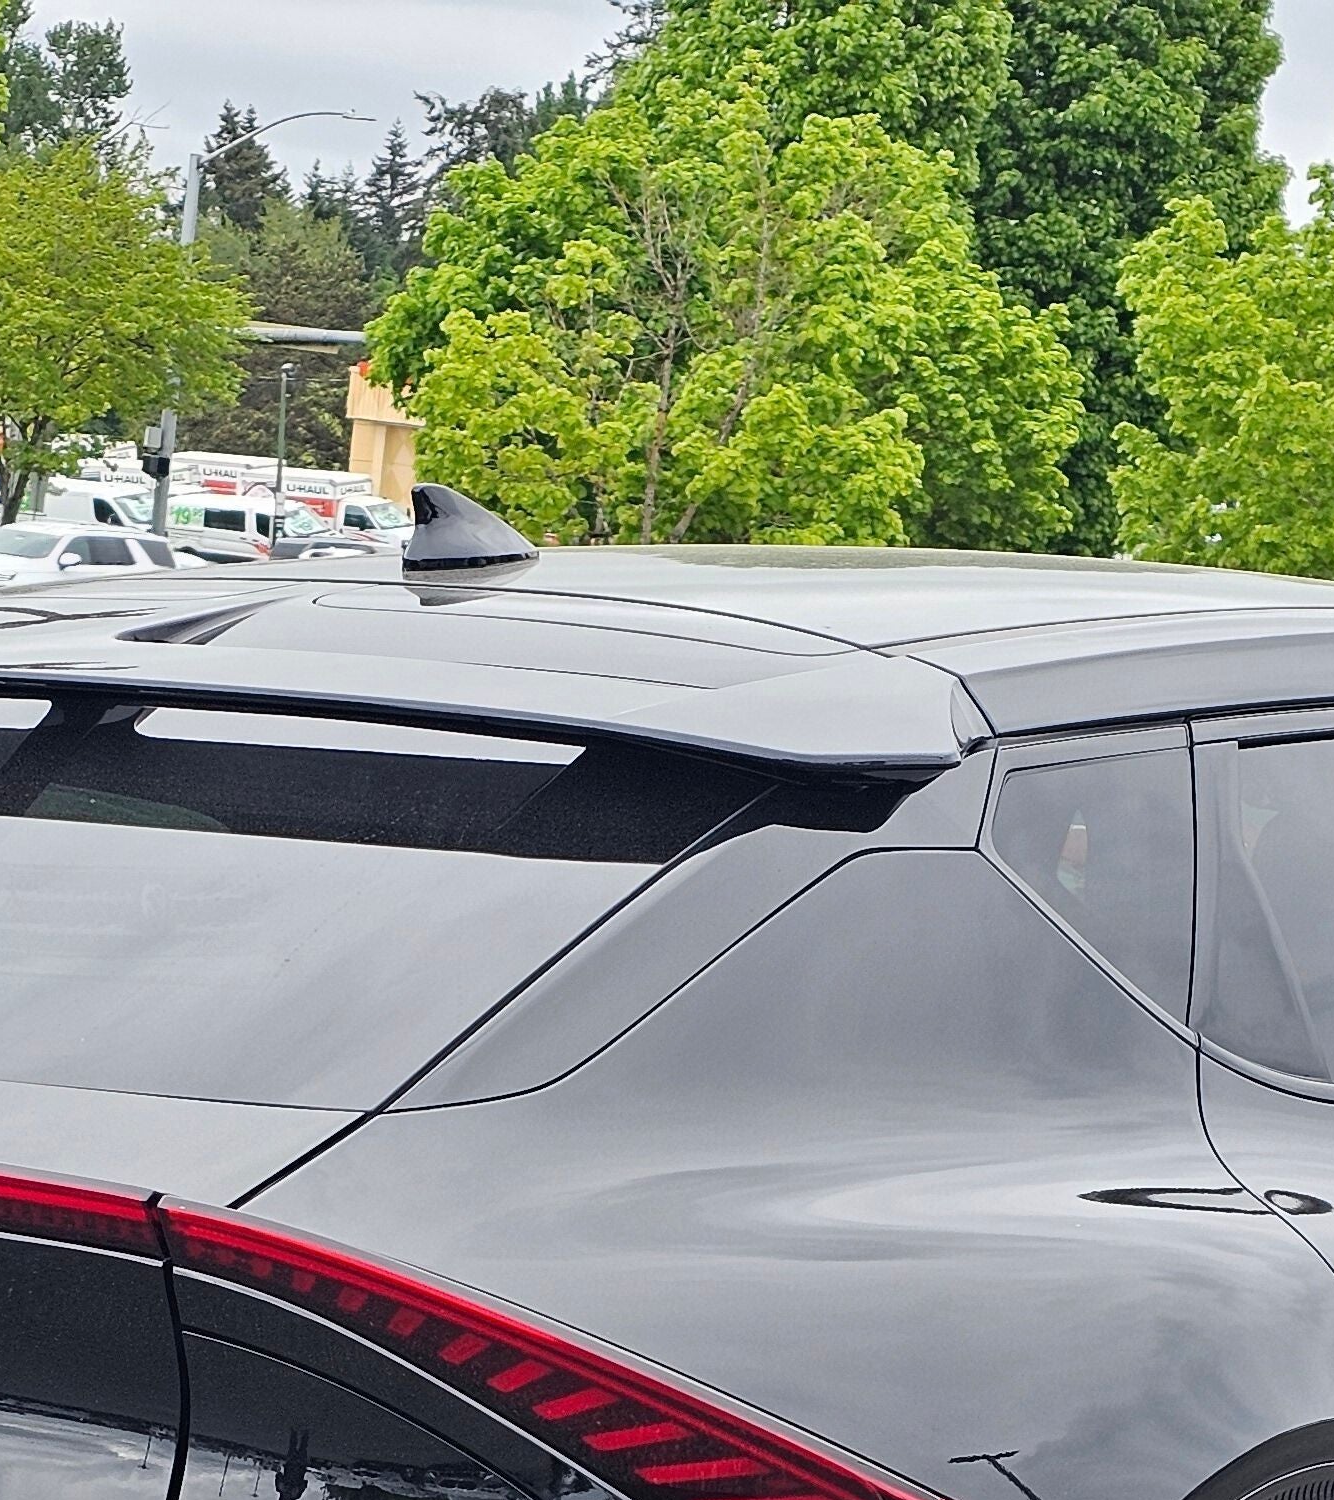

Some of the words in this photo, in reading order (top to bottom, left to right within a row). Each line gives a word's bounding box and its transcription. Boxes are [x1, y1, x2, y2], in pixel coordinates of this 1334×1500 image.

[104, 473, 146, 485] U-HAUL
[202, 467, 238, 479] U-HAU
[286, 483, 330, 495] U-HAUL
